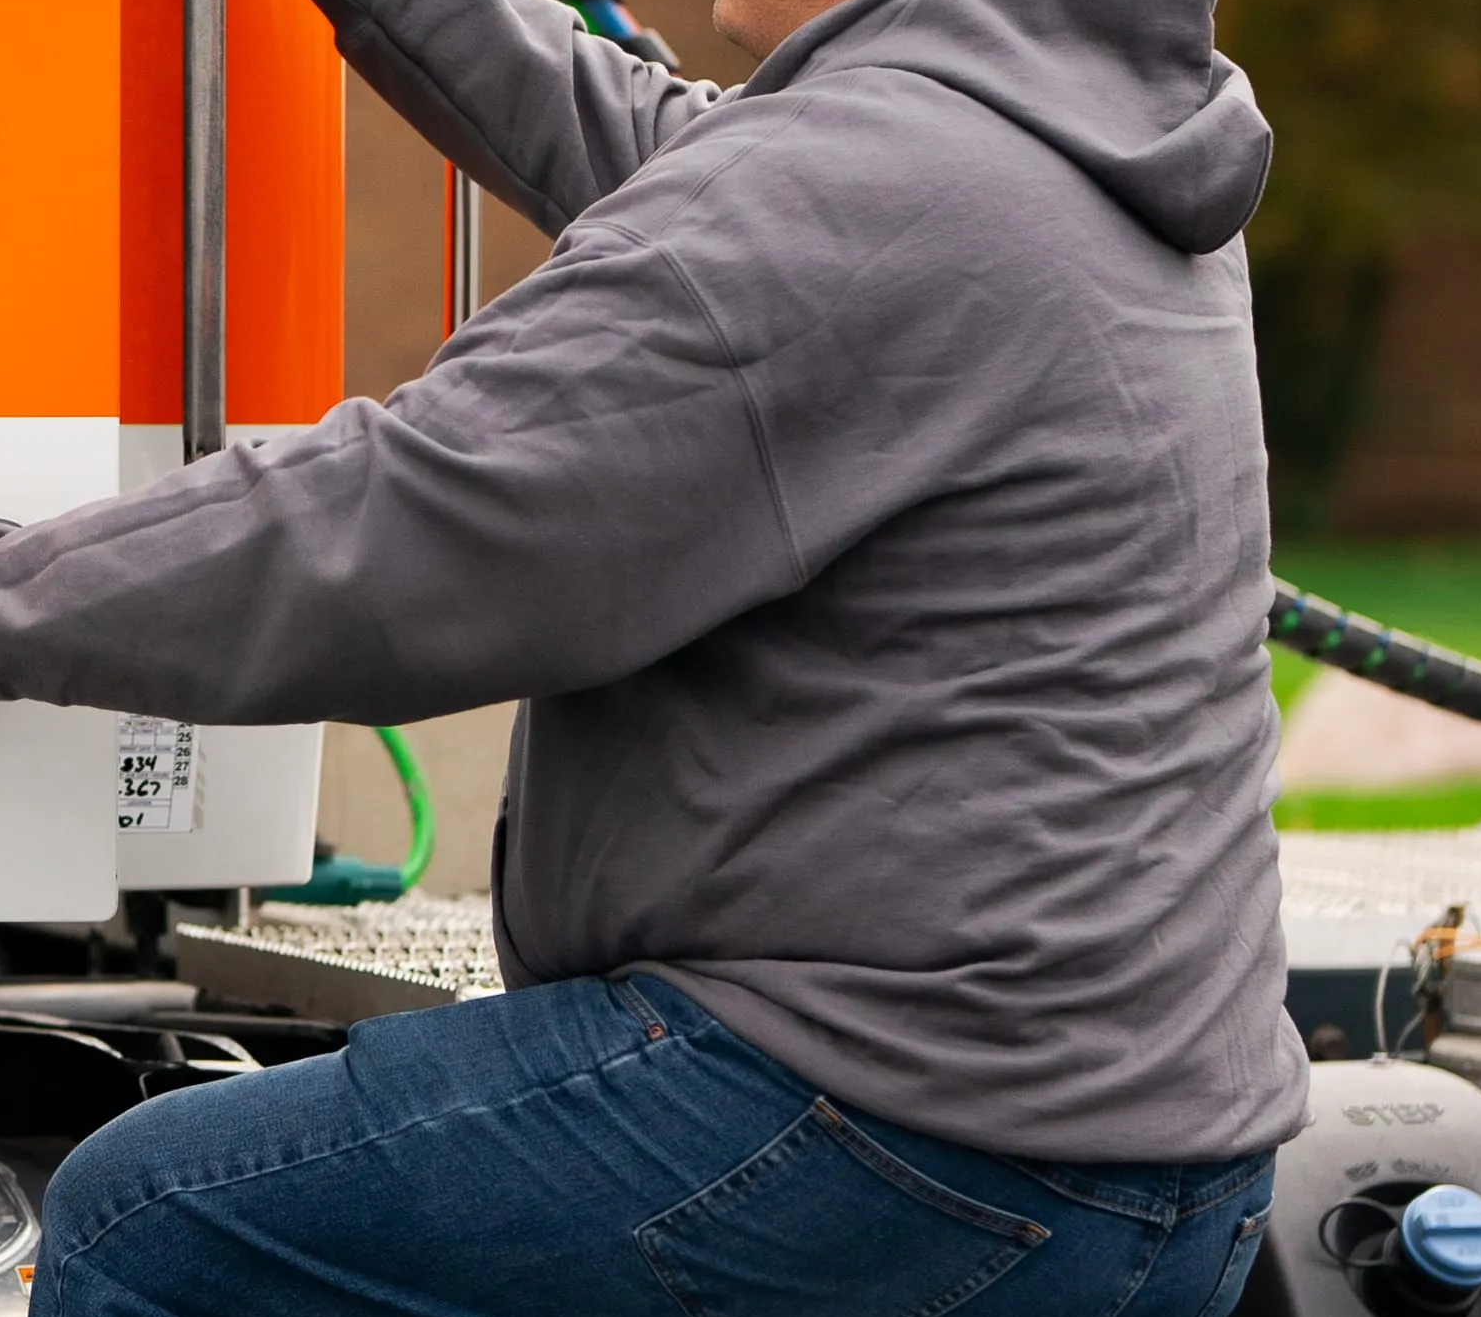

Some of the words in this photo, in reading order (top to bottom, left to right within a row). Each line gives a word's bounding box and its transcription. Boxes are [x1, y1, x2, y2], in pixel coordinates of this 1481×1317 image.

[177, 732, 192, 743] 25
[176, 747, 191, 757] 26
[174, 761, 190, 772] 27
[172, 776, 188, 786] 28
